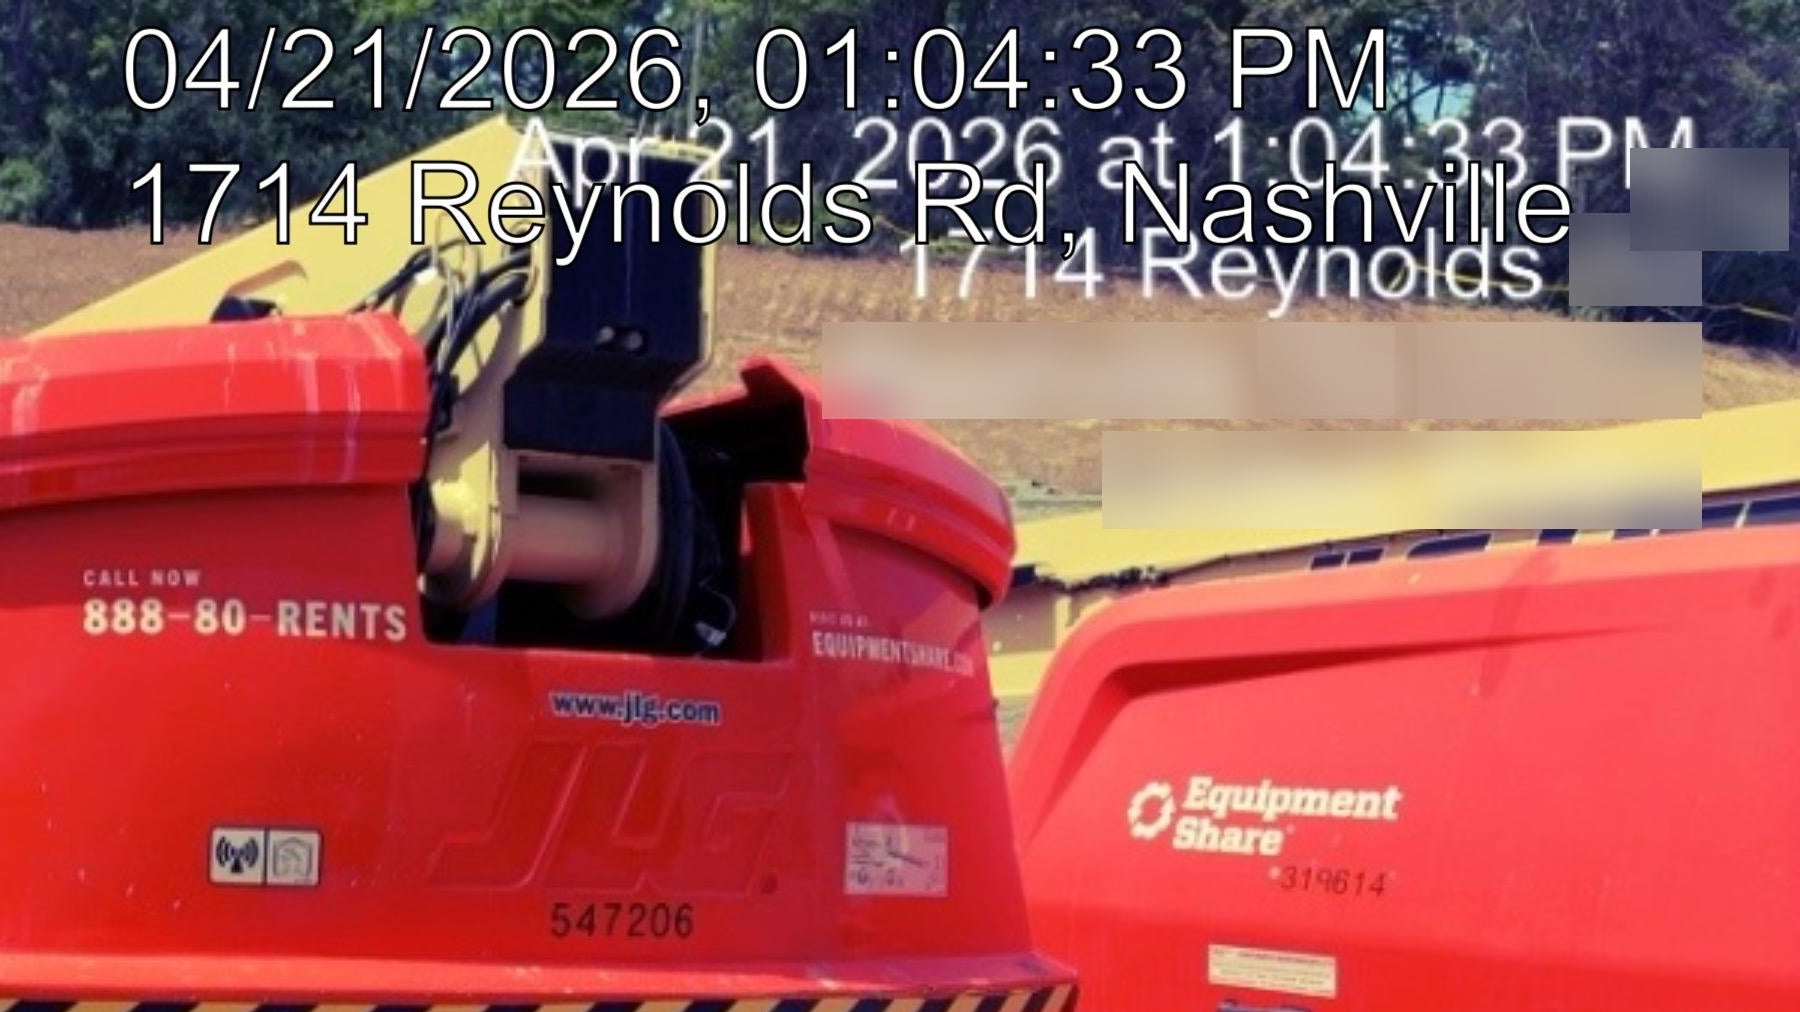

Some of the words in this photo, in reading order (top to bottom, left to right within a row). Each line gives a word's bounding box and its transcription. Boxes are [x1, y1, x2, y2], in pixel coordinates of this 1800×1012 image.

[83, 569, 140, 587] CALL
[151, 570, 201, 587] NOW
[83, 597, 408, 643] 888-80-RENTS
[550, 690, 721, 727] www.jlg.com
[1182, 775, 1404, 821] Equipment
[1172, 815, 1285, 856] Share
[1281, 865, 1389, 897] 319614
[550, 902, 695, 939] 547206
